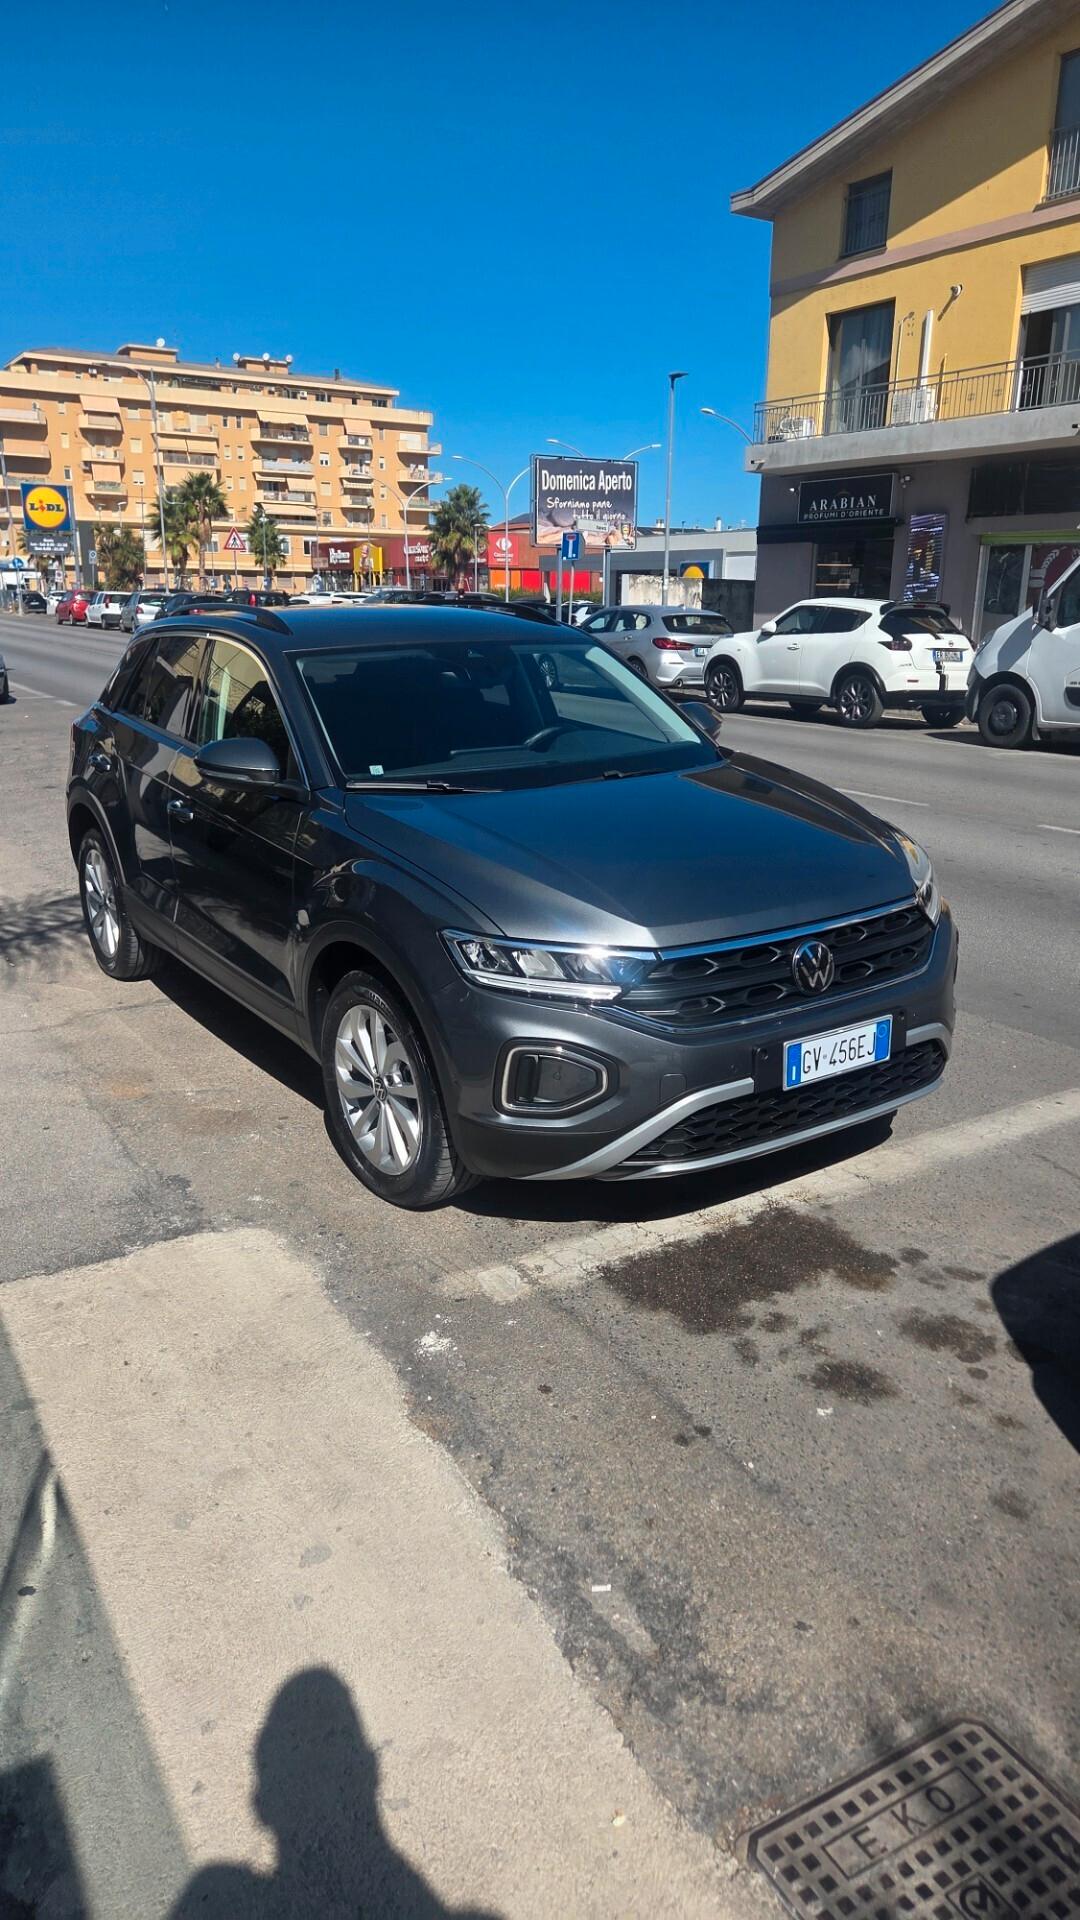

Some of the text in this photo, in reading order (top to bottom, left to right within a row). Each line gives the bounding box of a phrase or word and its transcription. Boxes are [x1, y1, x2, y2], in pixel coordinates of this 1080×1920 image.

[542, 470, 632, 494] Domenica Aperto
[546, 497, 613, 512] Sforniamo pane
[809, 495, 877, 512] ARABIAN
[573, 509, 593, 520] tutto
[602, 510, 626, 522] giorno
[803, 508, 884, 520] PROFUMI D'ORIENTE
